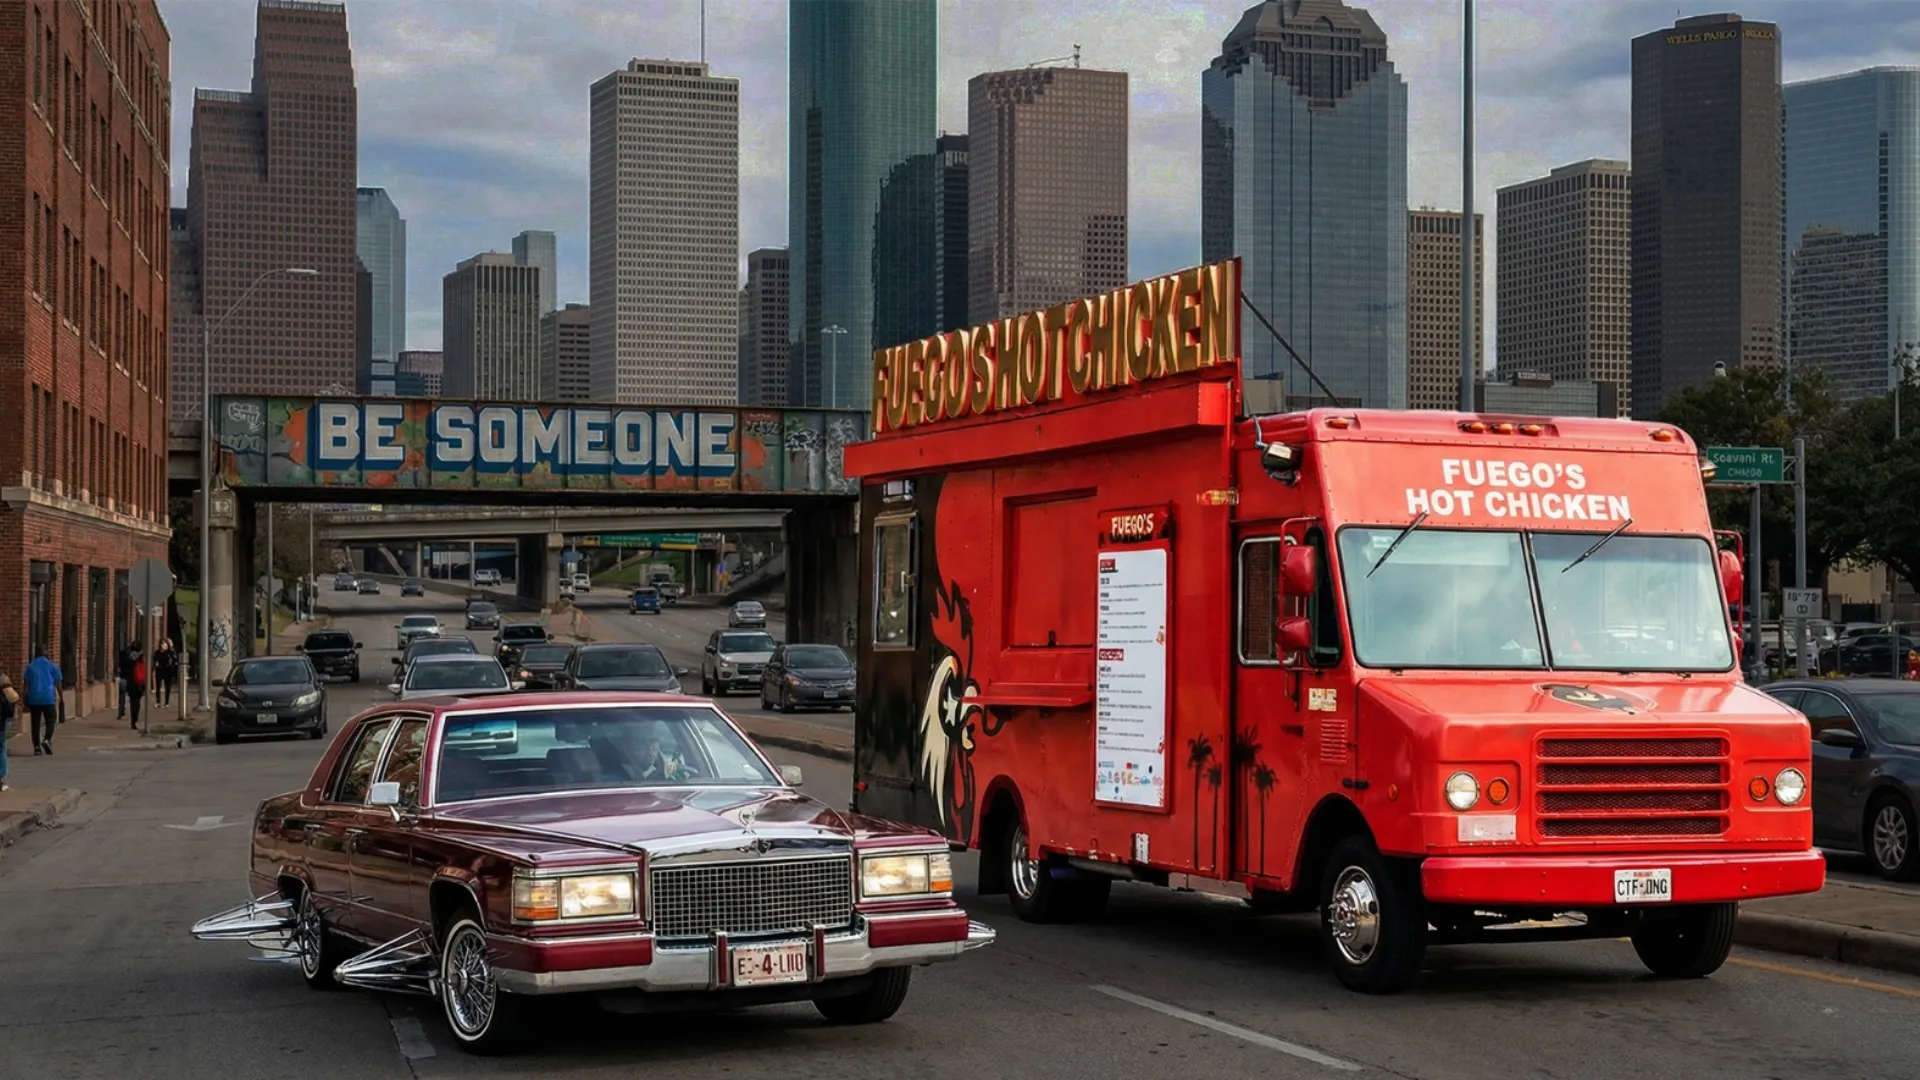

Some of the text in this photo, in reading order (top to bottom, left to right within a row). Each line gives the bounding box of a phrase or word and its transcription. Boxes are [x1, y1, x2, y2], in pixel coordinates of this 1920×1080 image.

[995, 301, 1068, 410] HOT
[1067, 259, 1237, 394] CHICKEN
[316, 402, 404, 462] BE
[435, 404, 736, 469] SOMEONE
[1441, 458, 1587, 490] FUEGO'S
[1405, 488, 1632, 521] HOT CHICKEN
[1111, 512, 1154, 536] FUEGO'S
